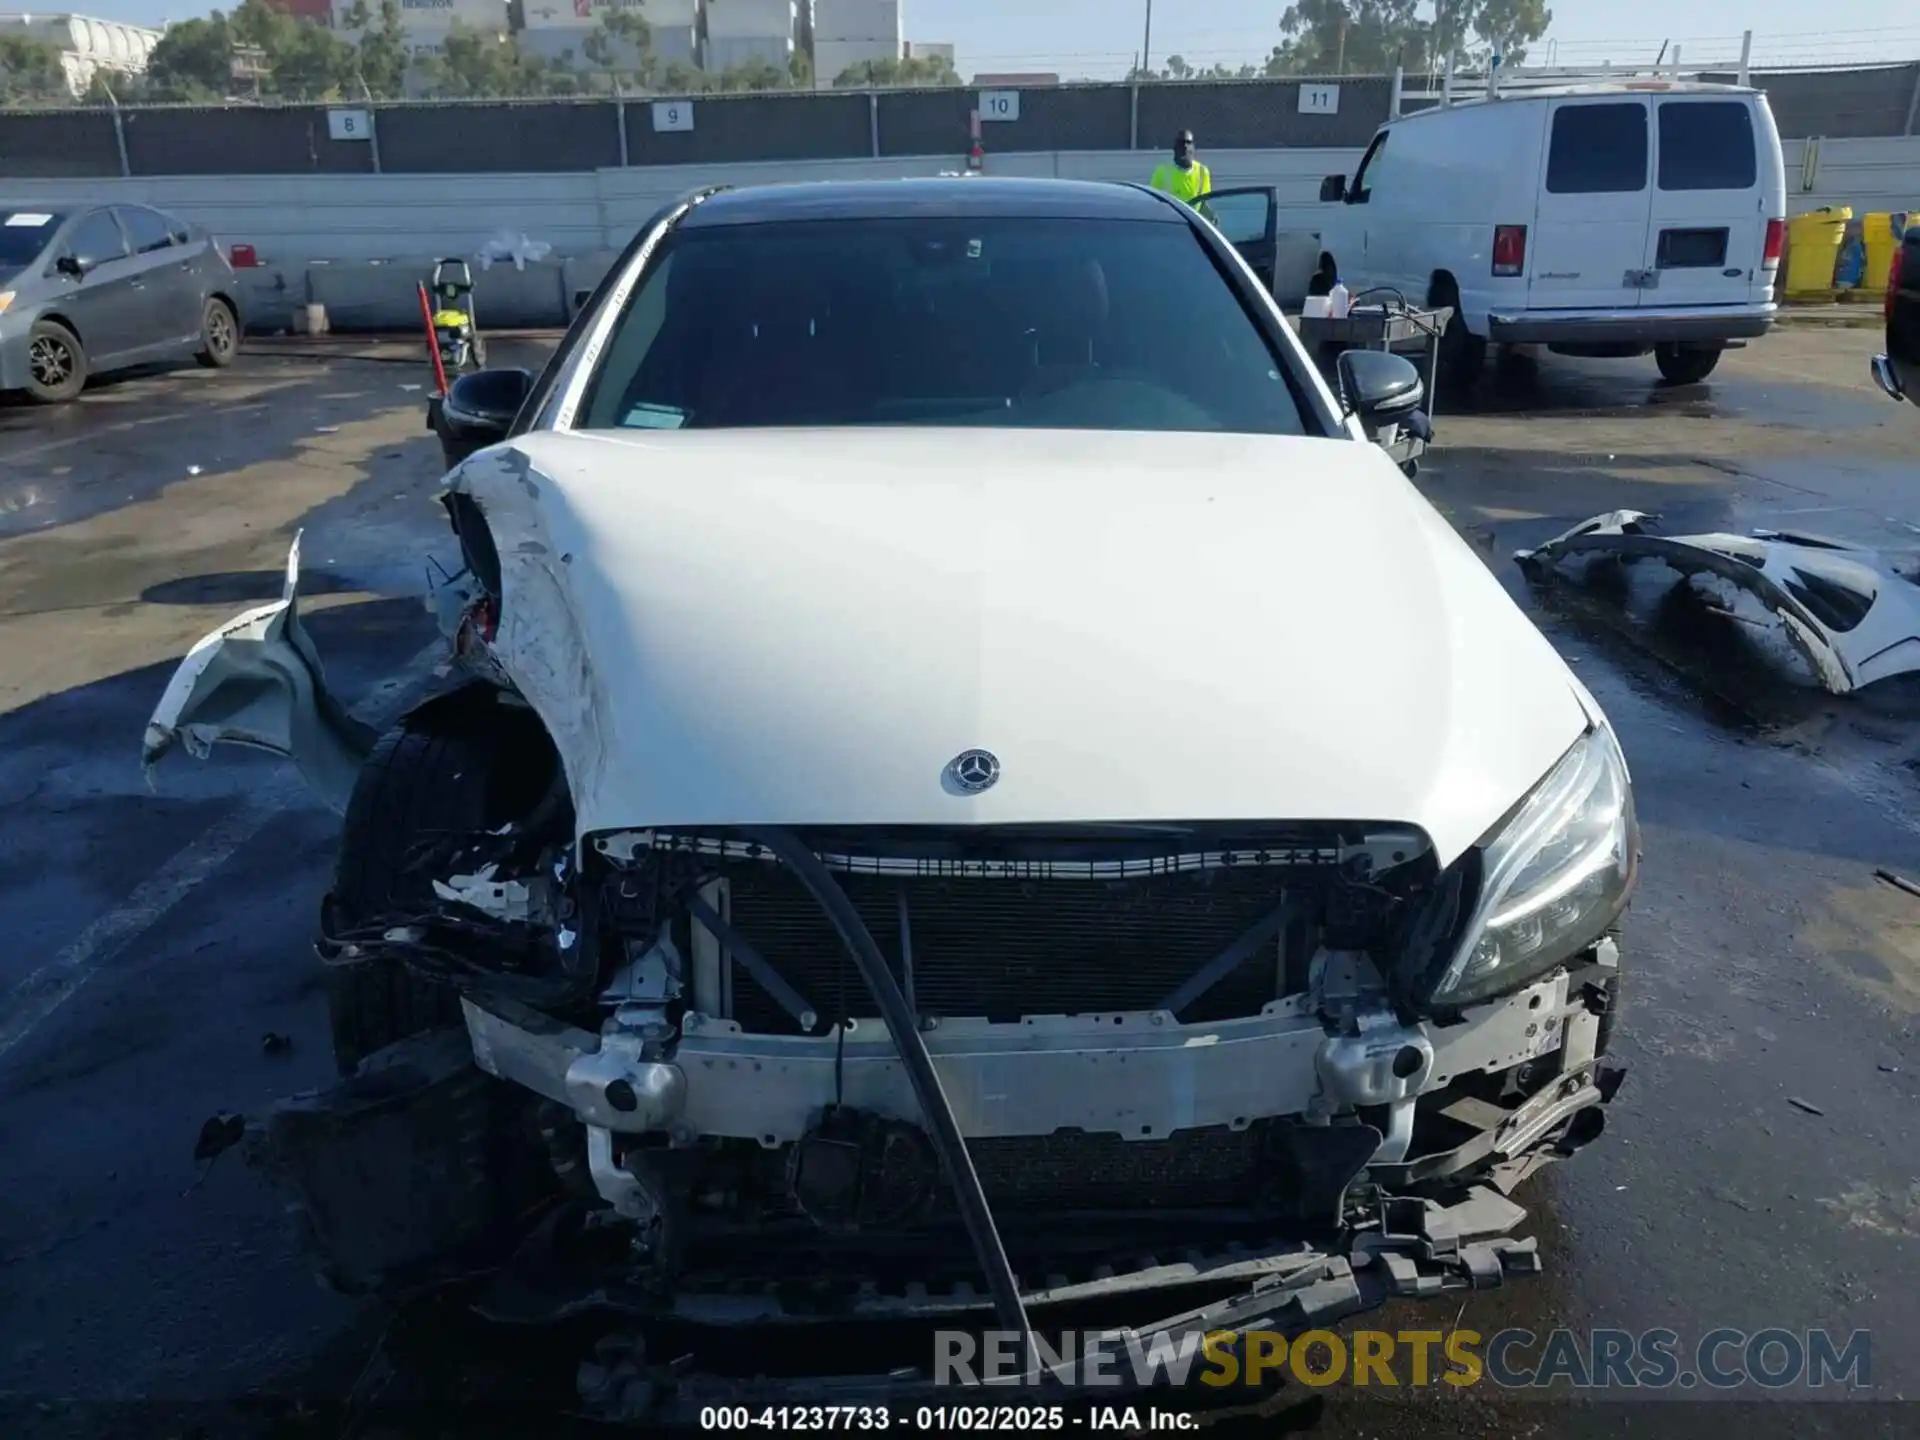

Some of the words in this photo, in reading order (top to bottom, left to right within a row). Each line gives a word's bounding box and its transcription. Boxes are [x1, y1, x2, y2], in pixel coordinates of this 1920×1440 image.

[988, 98, 1008, 114] 10
[1311, 91, 1328, 107] 11
[668, 109, 678, 124] 9
[344, 118, 354, 132] 8
